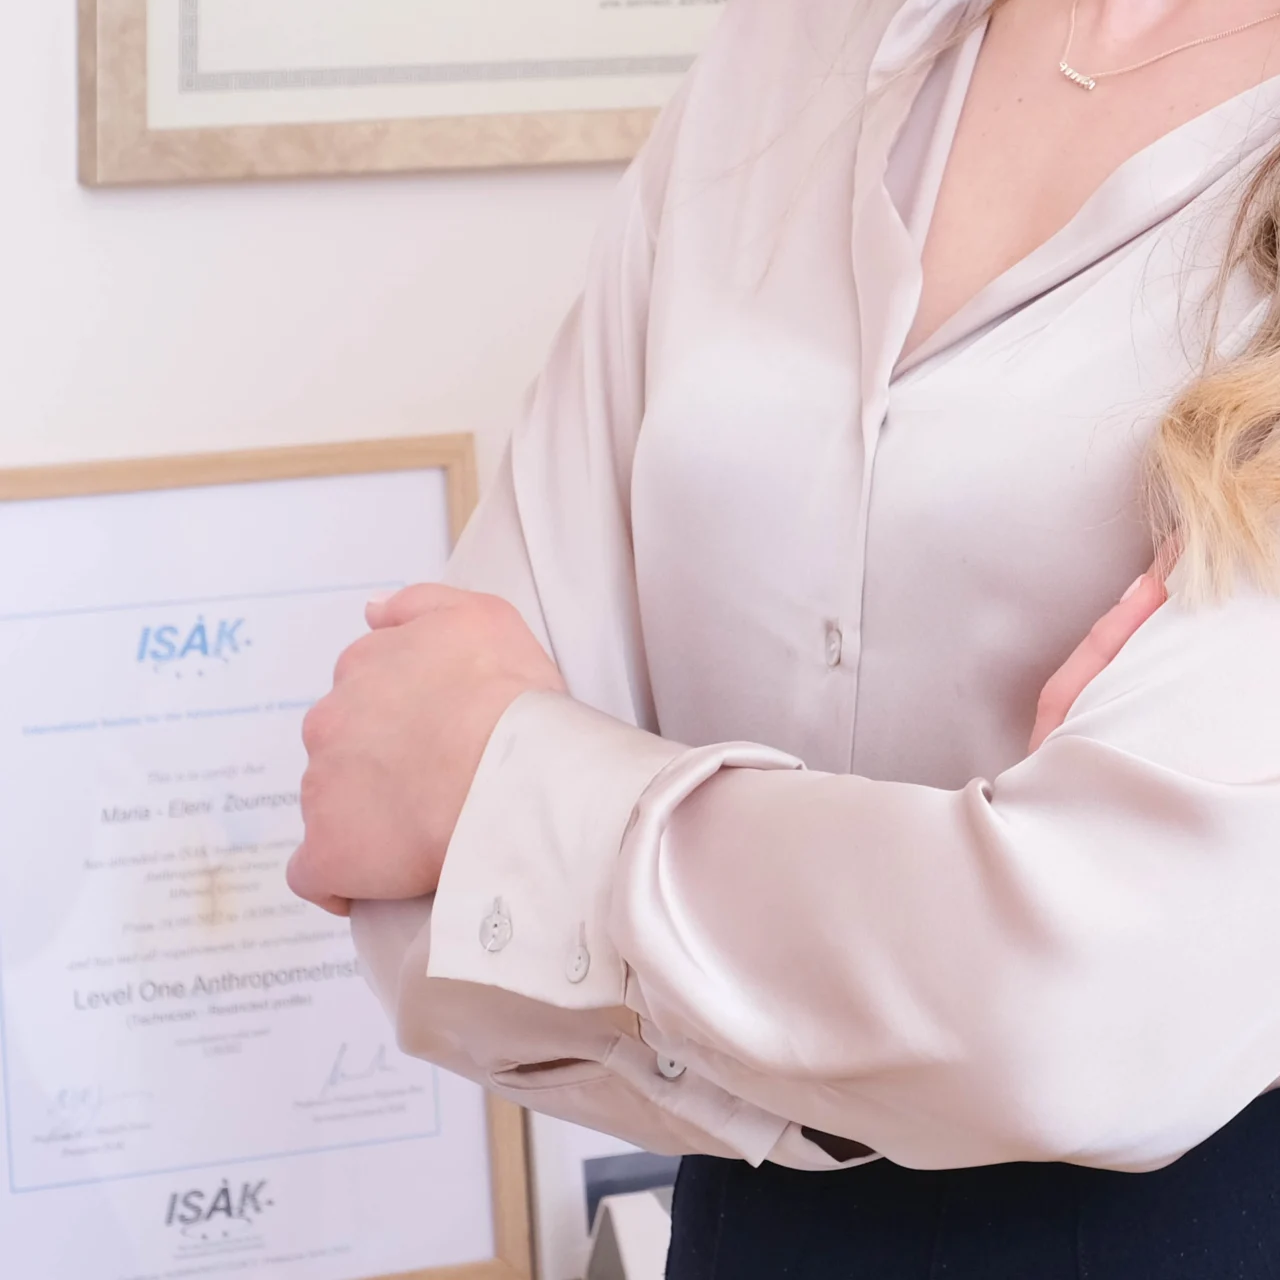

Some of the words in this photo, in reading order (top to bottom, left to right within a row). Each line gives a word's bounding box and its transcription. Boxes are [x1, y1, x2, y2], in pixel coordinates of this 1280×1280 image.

[101, 806, 151, 825] Maria
[73, 983, 132, 1010] Level
[139, 980, 186, 1003] One
[191, 959, 361, 997] Anthropometrist
